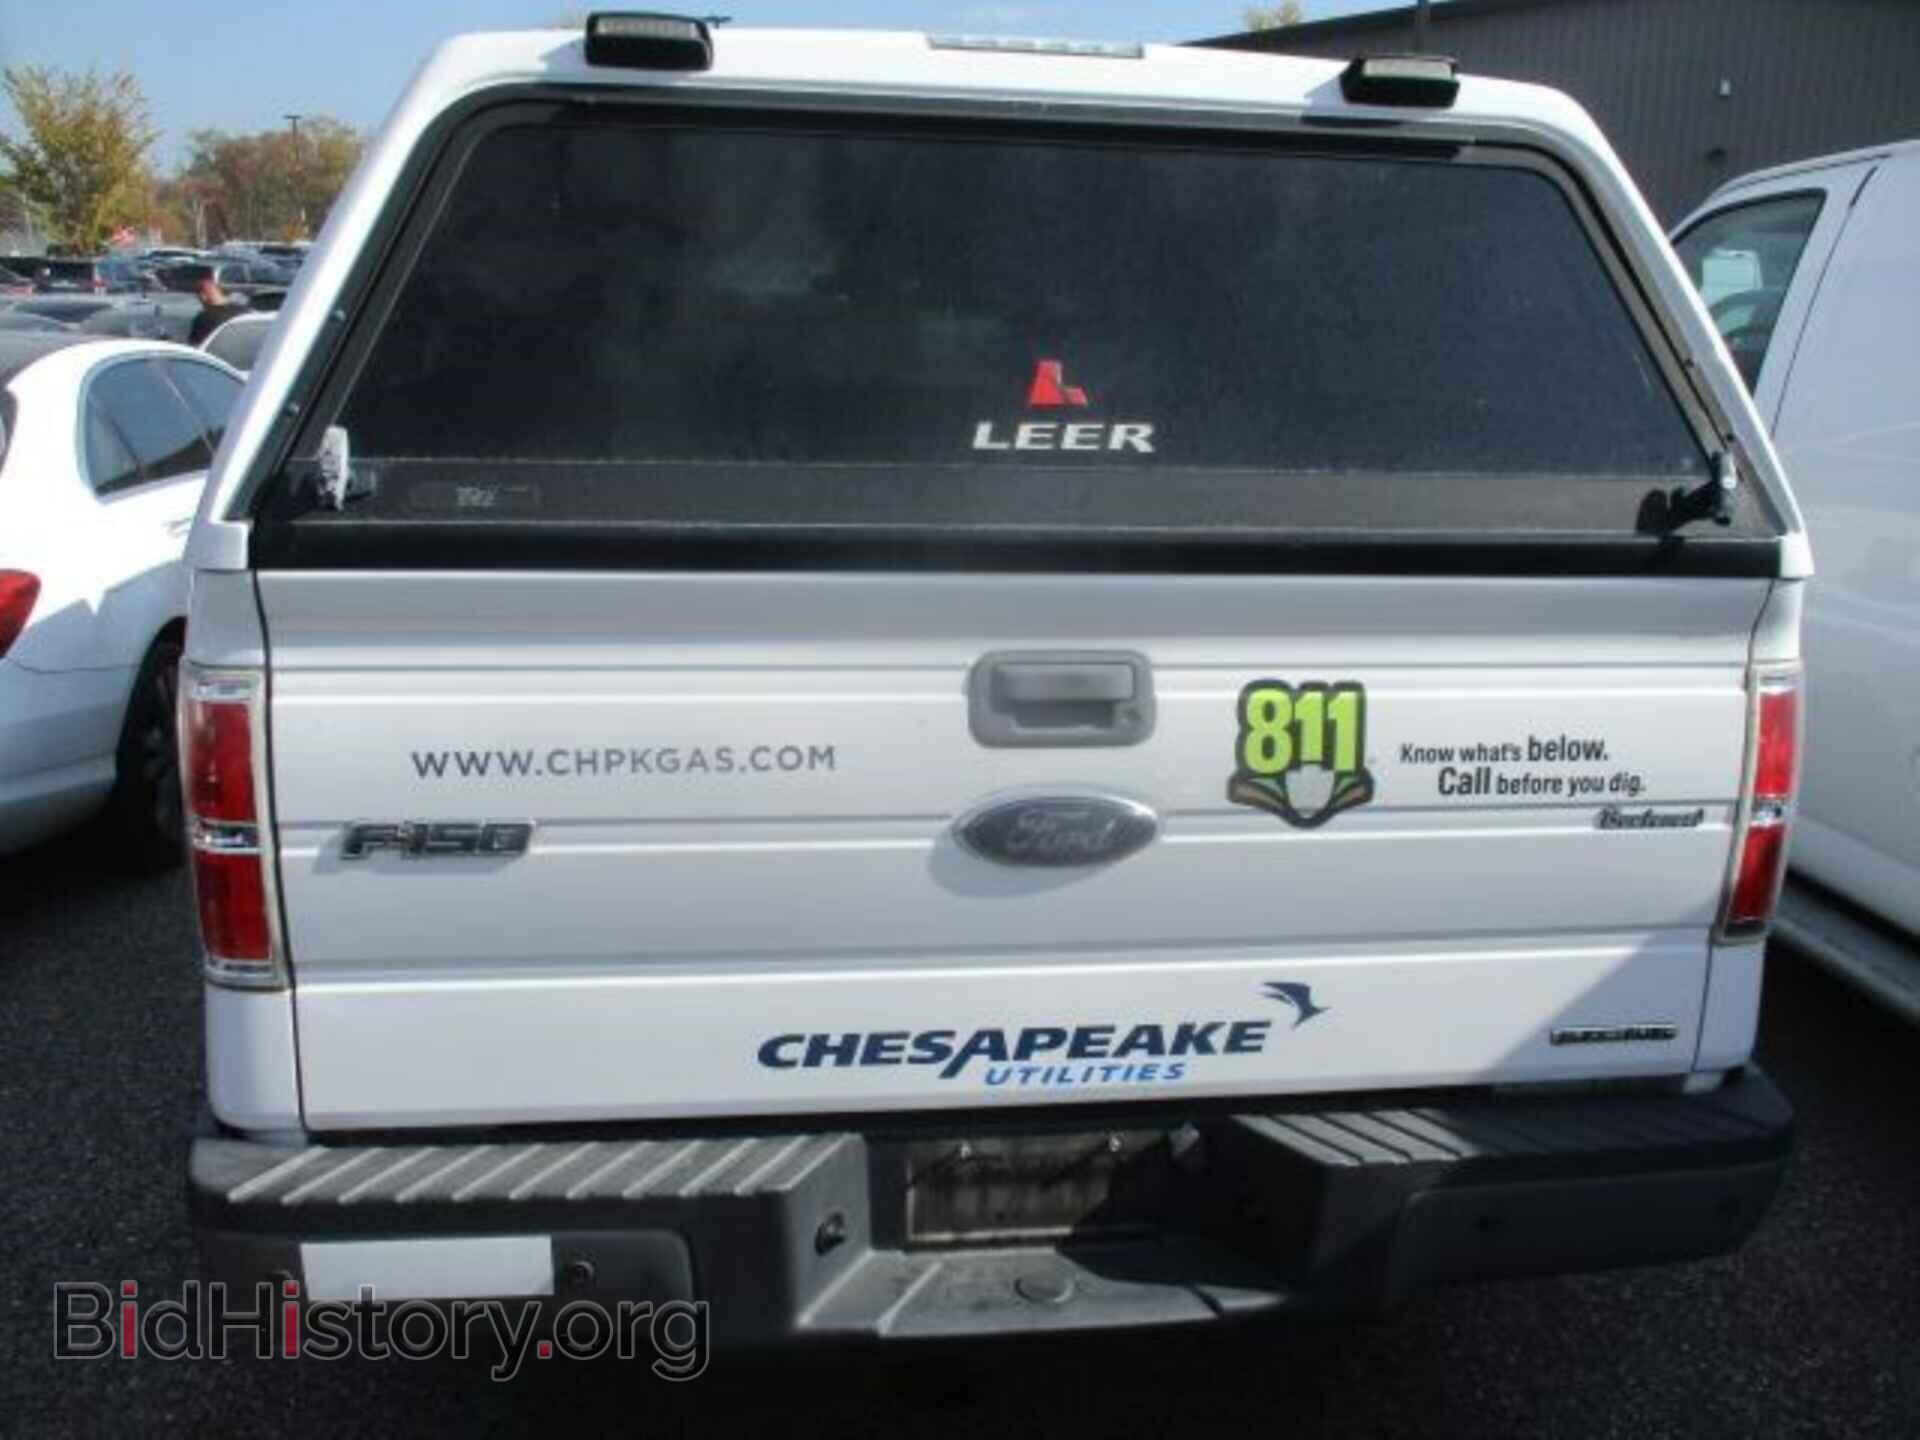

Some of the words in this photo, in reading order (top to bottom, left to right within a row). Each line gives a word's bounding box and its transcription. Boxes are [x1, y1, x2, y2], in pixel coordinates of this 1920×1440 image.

[972, 420, 1156, 453] LEER
[1243, 687, 1360, 775] 811
[411, 744, 837, 778] WWW.CHPKGAS.COM
[1400, 742, 1454, 764] Know
[1459, 741, 1522, 762] what's
[1528, 734, 1609, 763] below.
[1438, 766, 1491, 796] Call
[1497, 772, 1562, 795] before
[1568, 774, 1604, 797] you
[1609, 771, 1647, 797] dig.
[1007, 806, 1122, 858] Ford
[757, 1019, 1272, 1079] CHESAPEAKE
[985, 1062, 1186, 1086] UTILITIES
